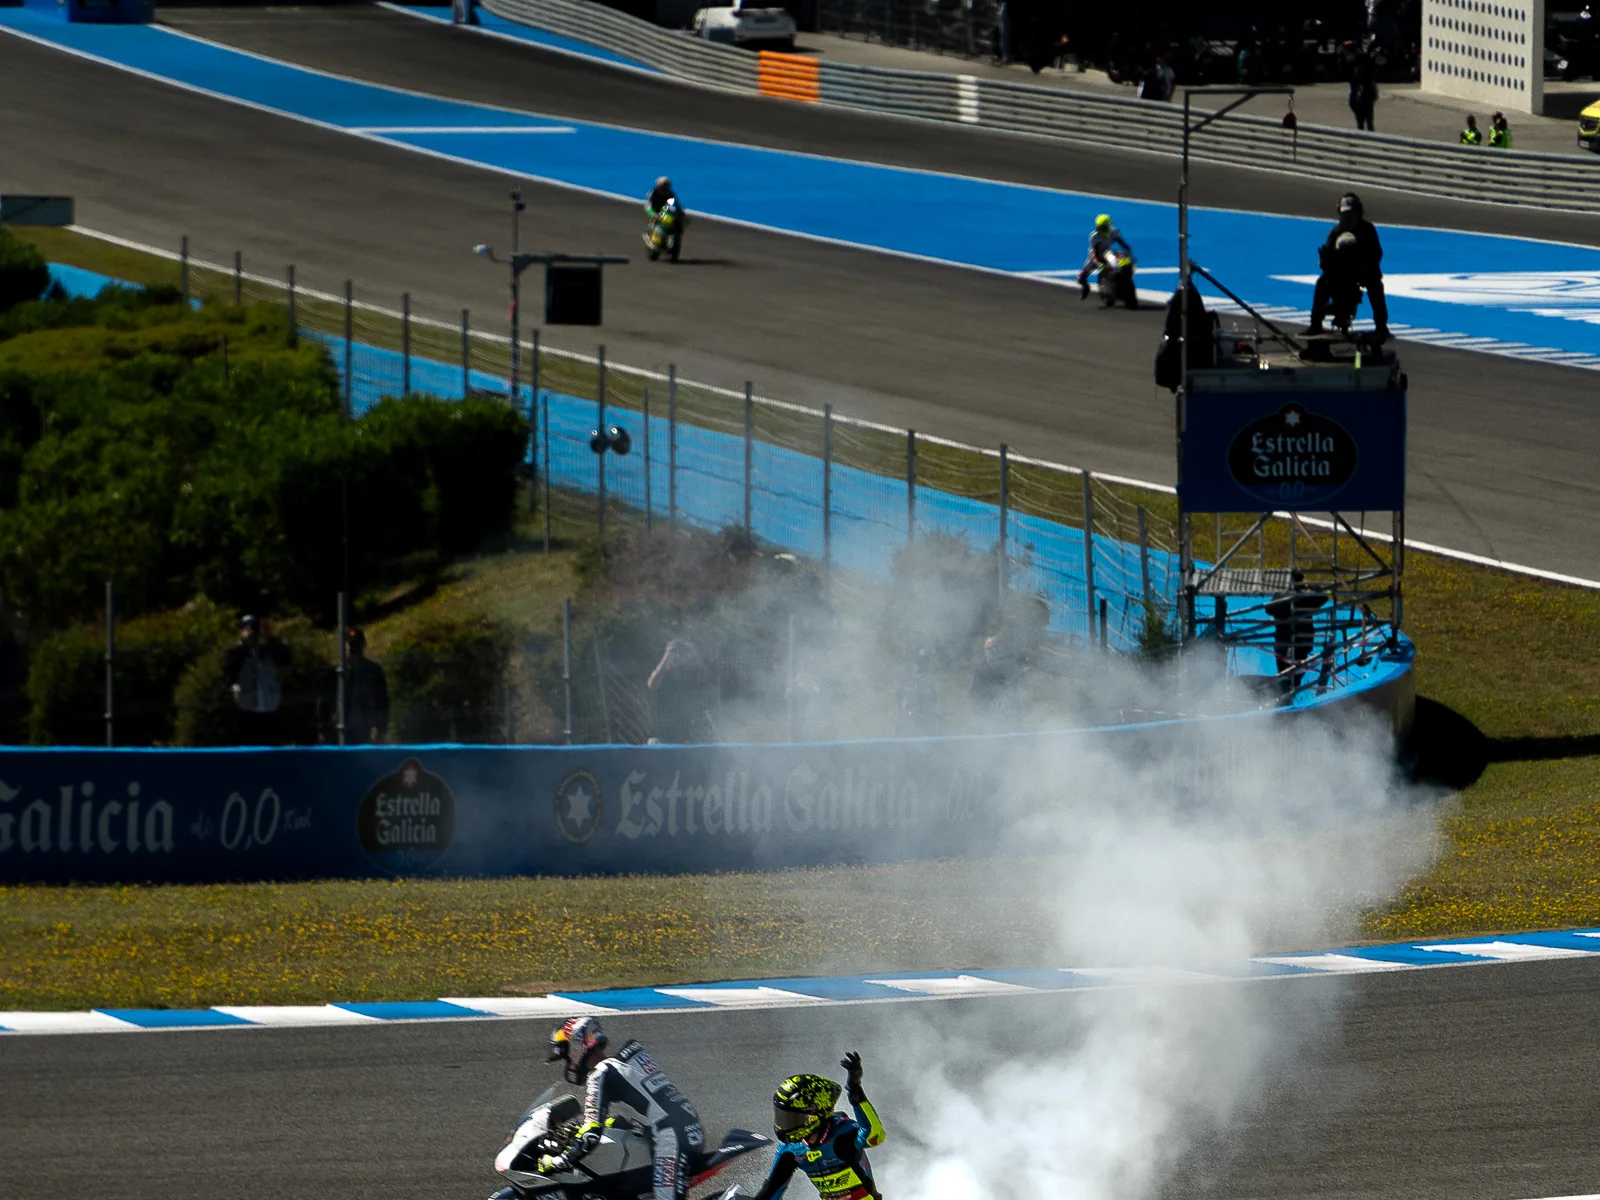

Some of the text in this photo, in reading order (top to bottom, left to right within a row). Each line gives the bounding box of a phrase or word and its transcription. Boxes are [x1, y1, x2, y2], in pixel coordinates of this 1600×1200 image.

[1251, 432, 1335, 453] Estrella
[1252, 454, 1331, 477] Galicia
[375, 792, 441, 817] Estrella
[614, 767, 774, 839] Estrella
[784, 763, 920, 834] Galicia
[376, 817, 437, 845] Galicia
